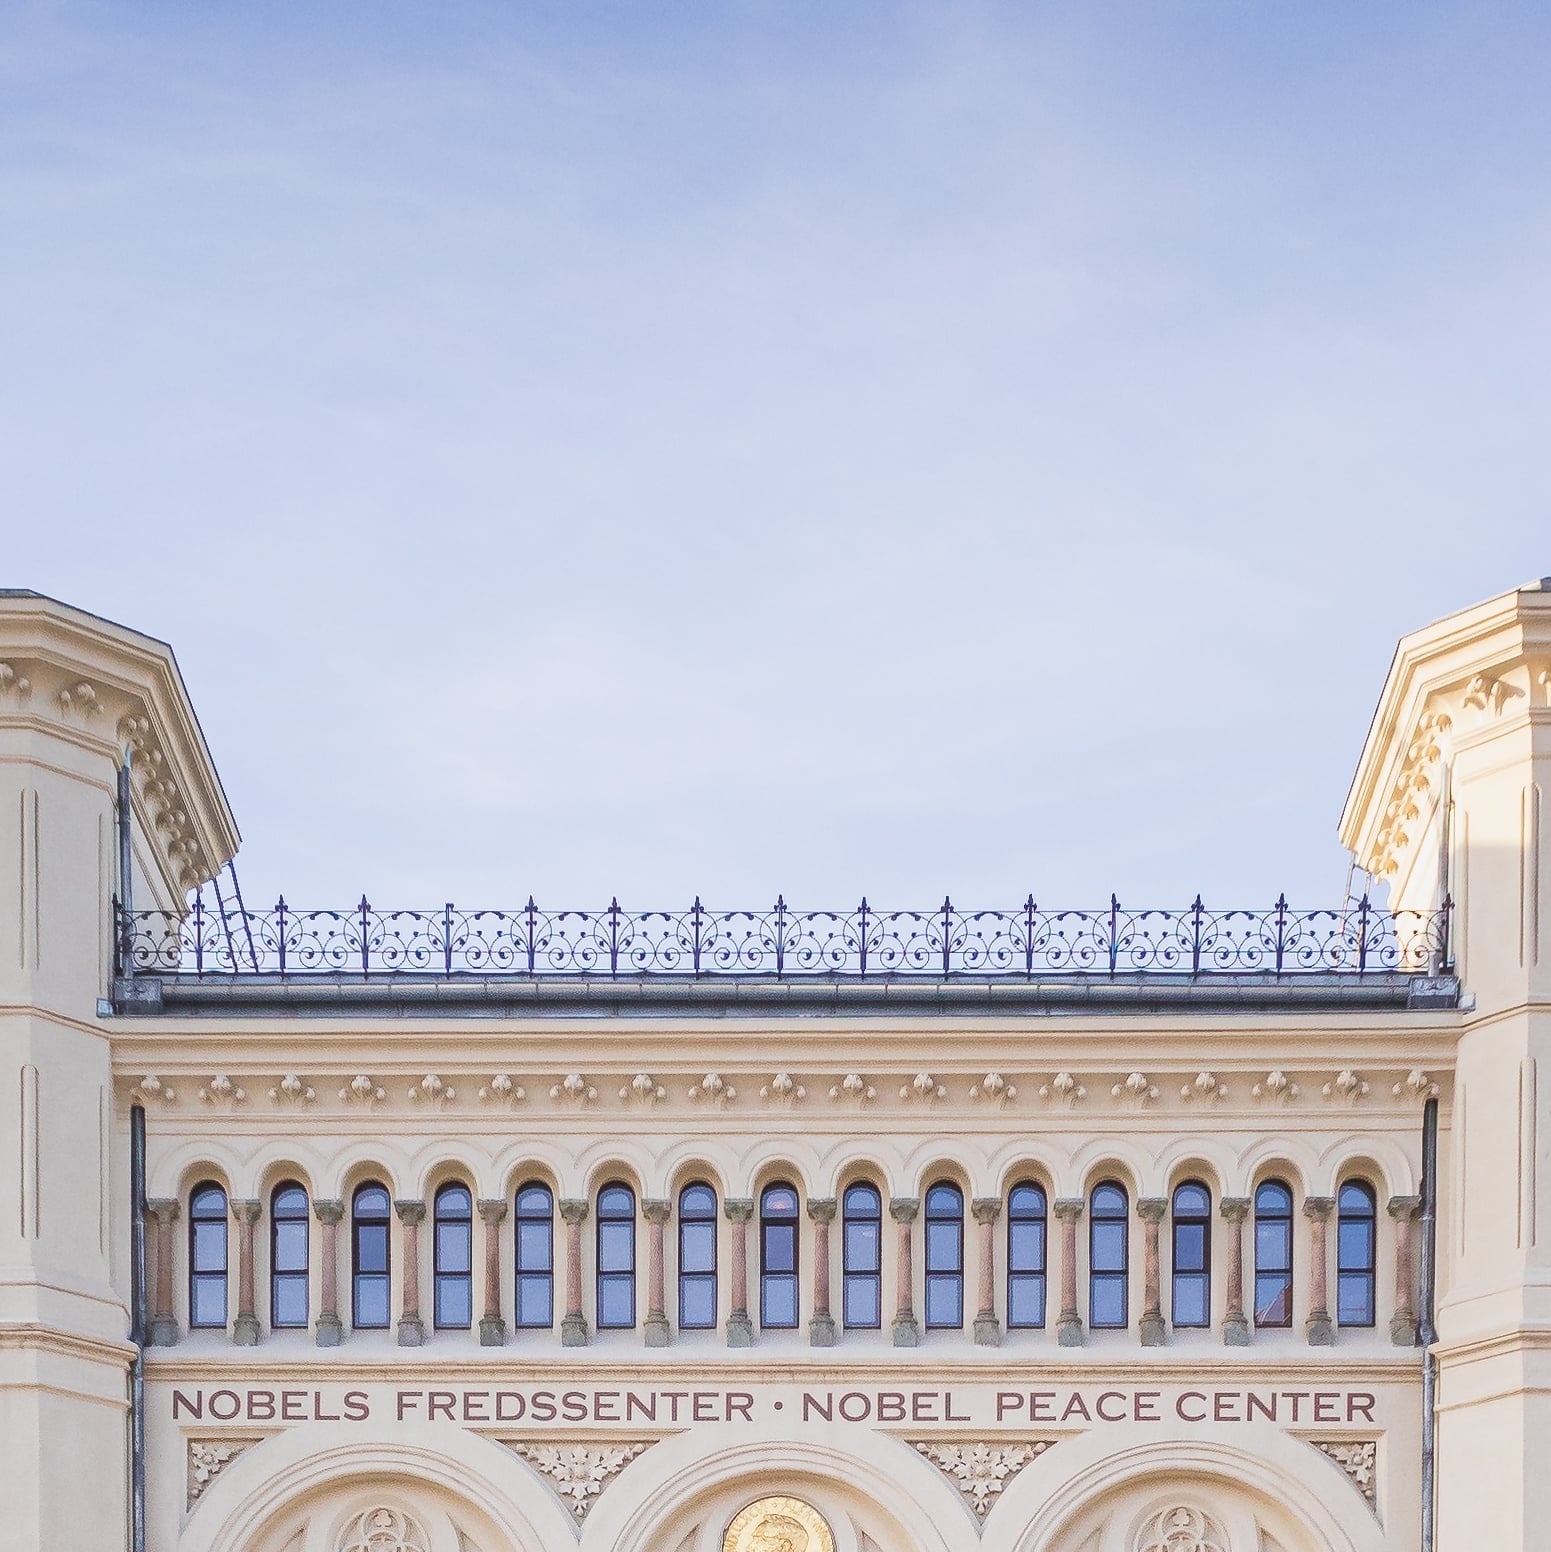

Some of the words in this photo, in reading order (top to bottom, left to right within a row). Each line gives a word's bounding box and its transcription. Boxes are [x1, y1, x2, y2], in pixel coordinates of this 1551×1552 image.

[172, 1389, 370, 1422] NOBELS
[396, 1390, 754, 1422] FREDSSENTER
[802, 1390, 972, 1423] NOBEL
[996, 1390, 1162, 1422] PEACE
[1175, 1390, 1376, 1423] CENTER
